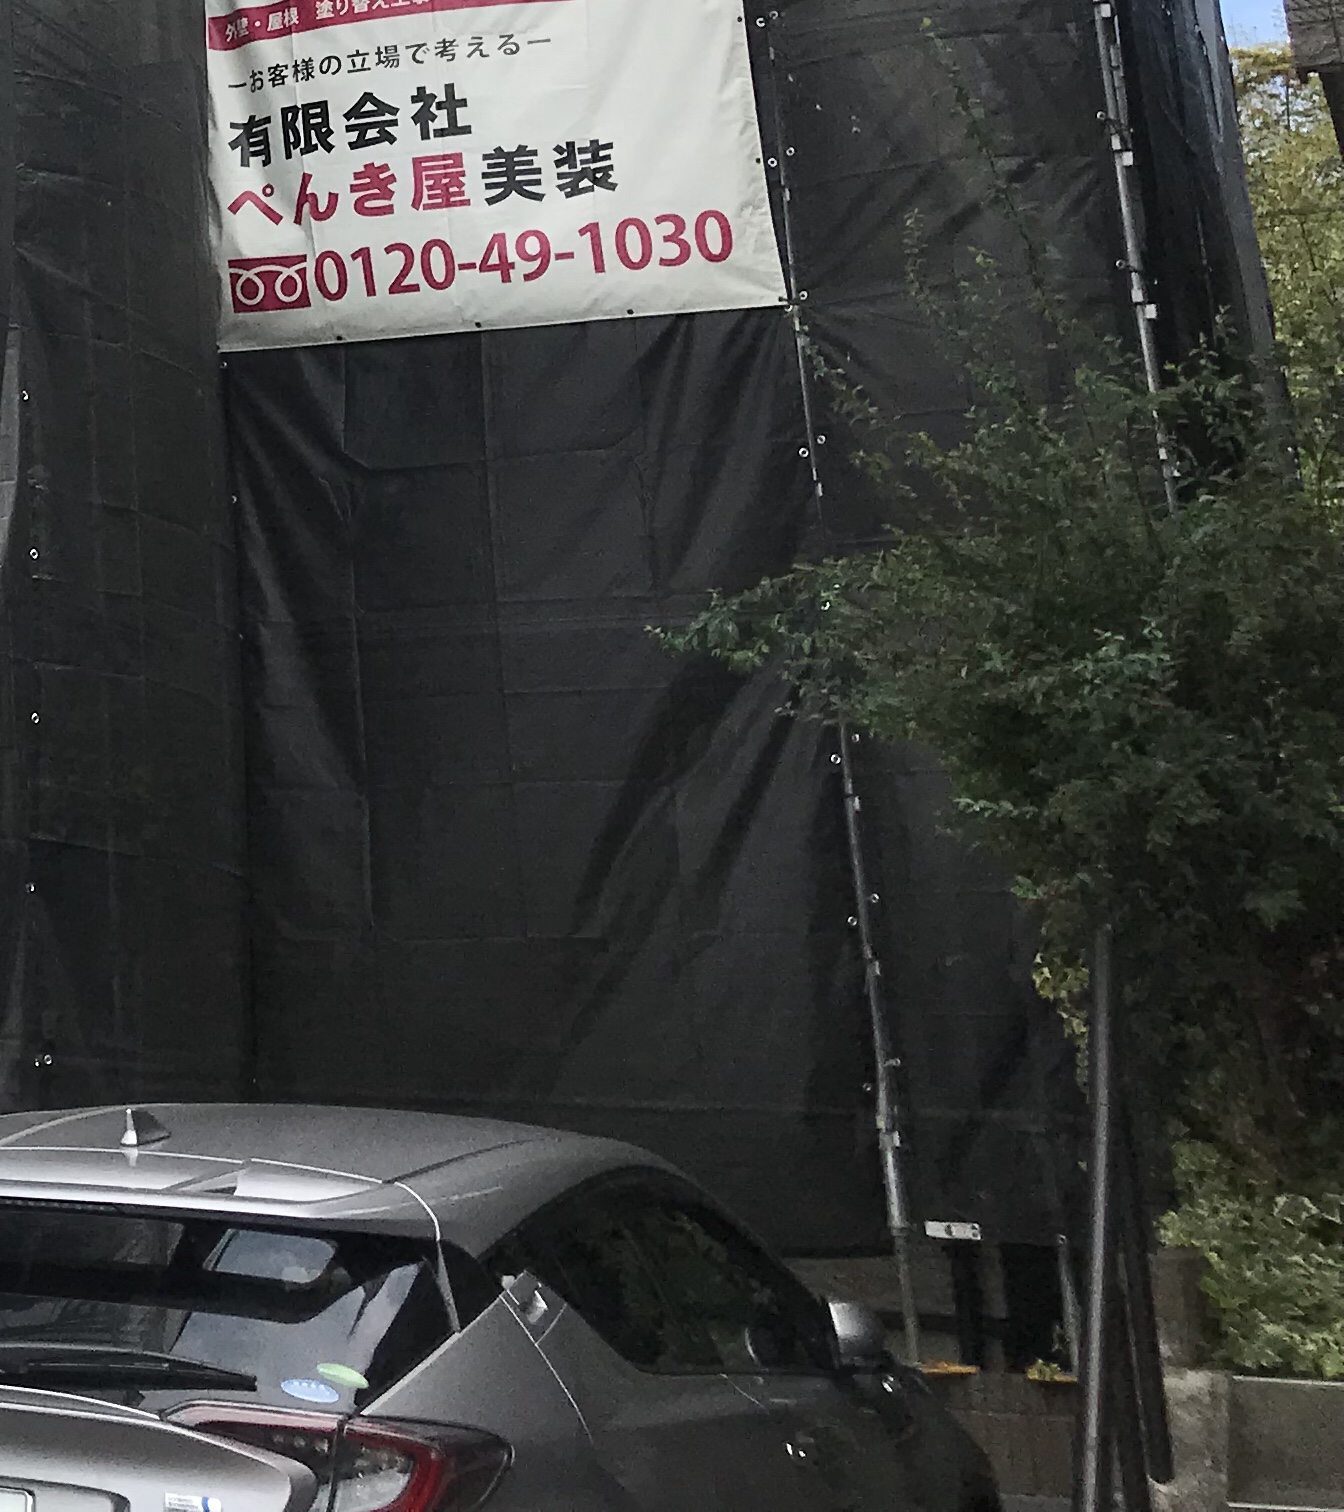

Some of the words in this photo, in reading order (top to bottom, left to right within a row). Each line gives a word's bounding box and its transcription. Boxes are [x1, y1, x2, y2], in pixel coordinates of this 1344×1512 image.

[228, 82, 473, 168] 有限会社
[313, 208, 734, 302] 0120-49-1030
